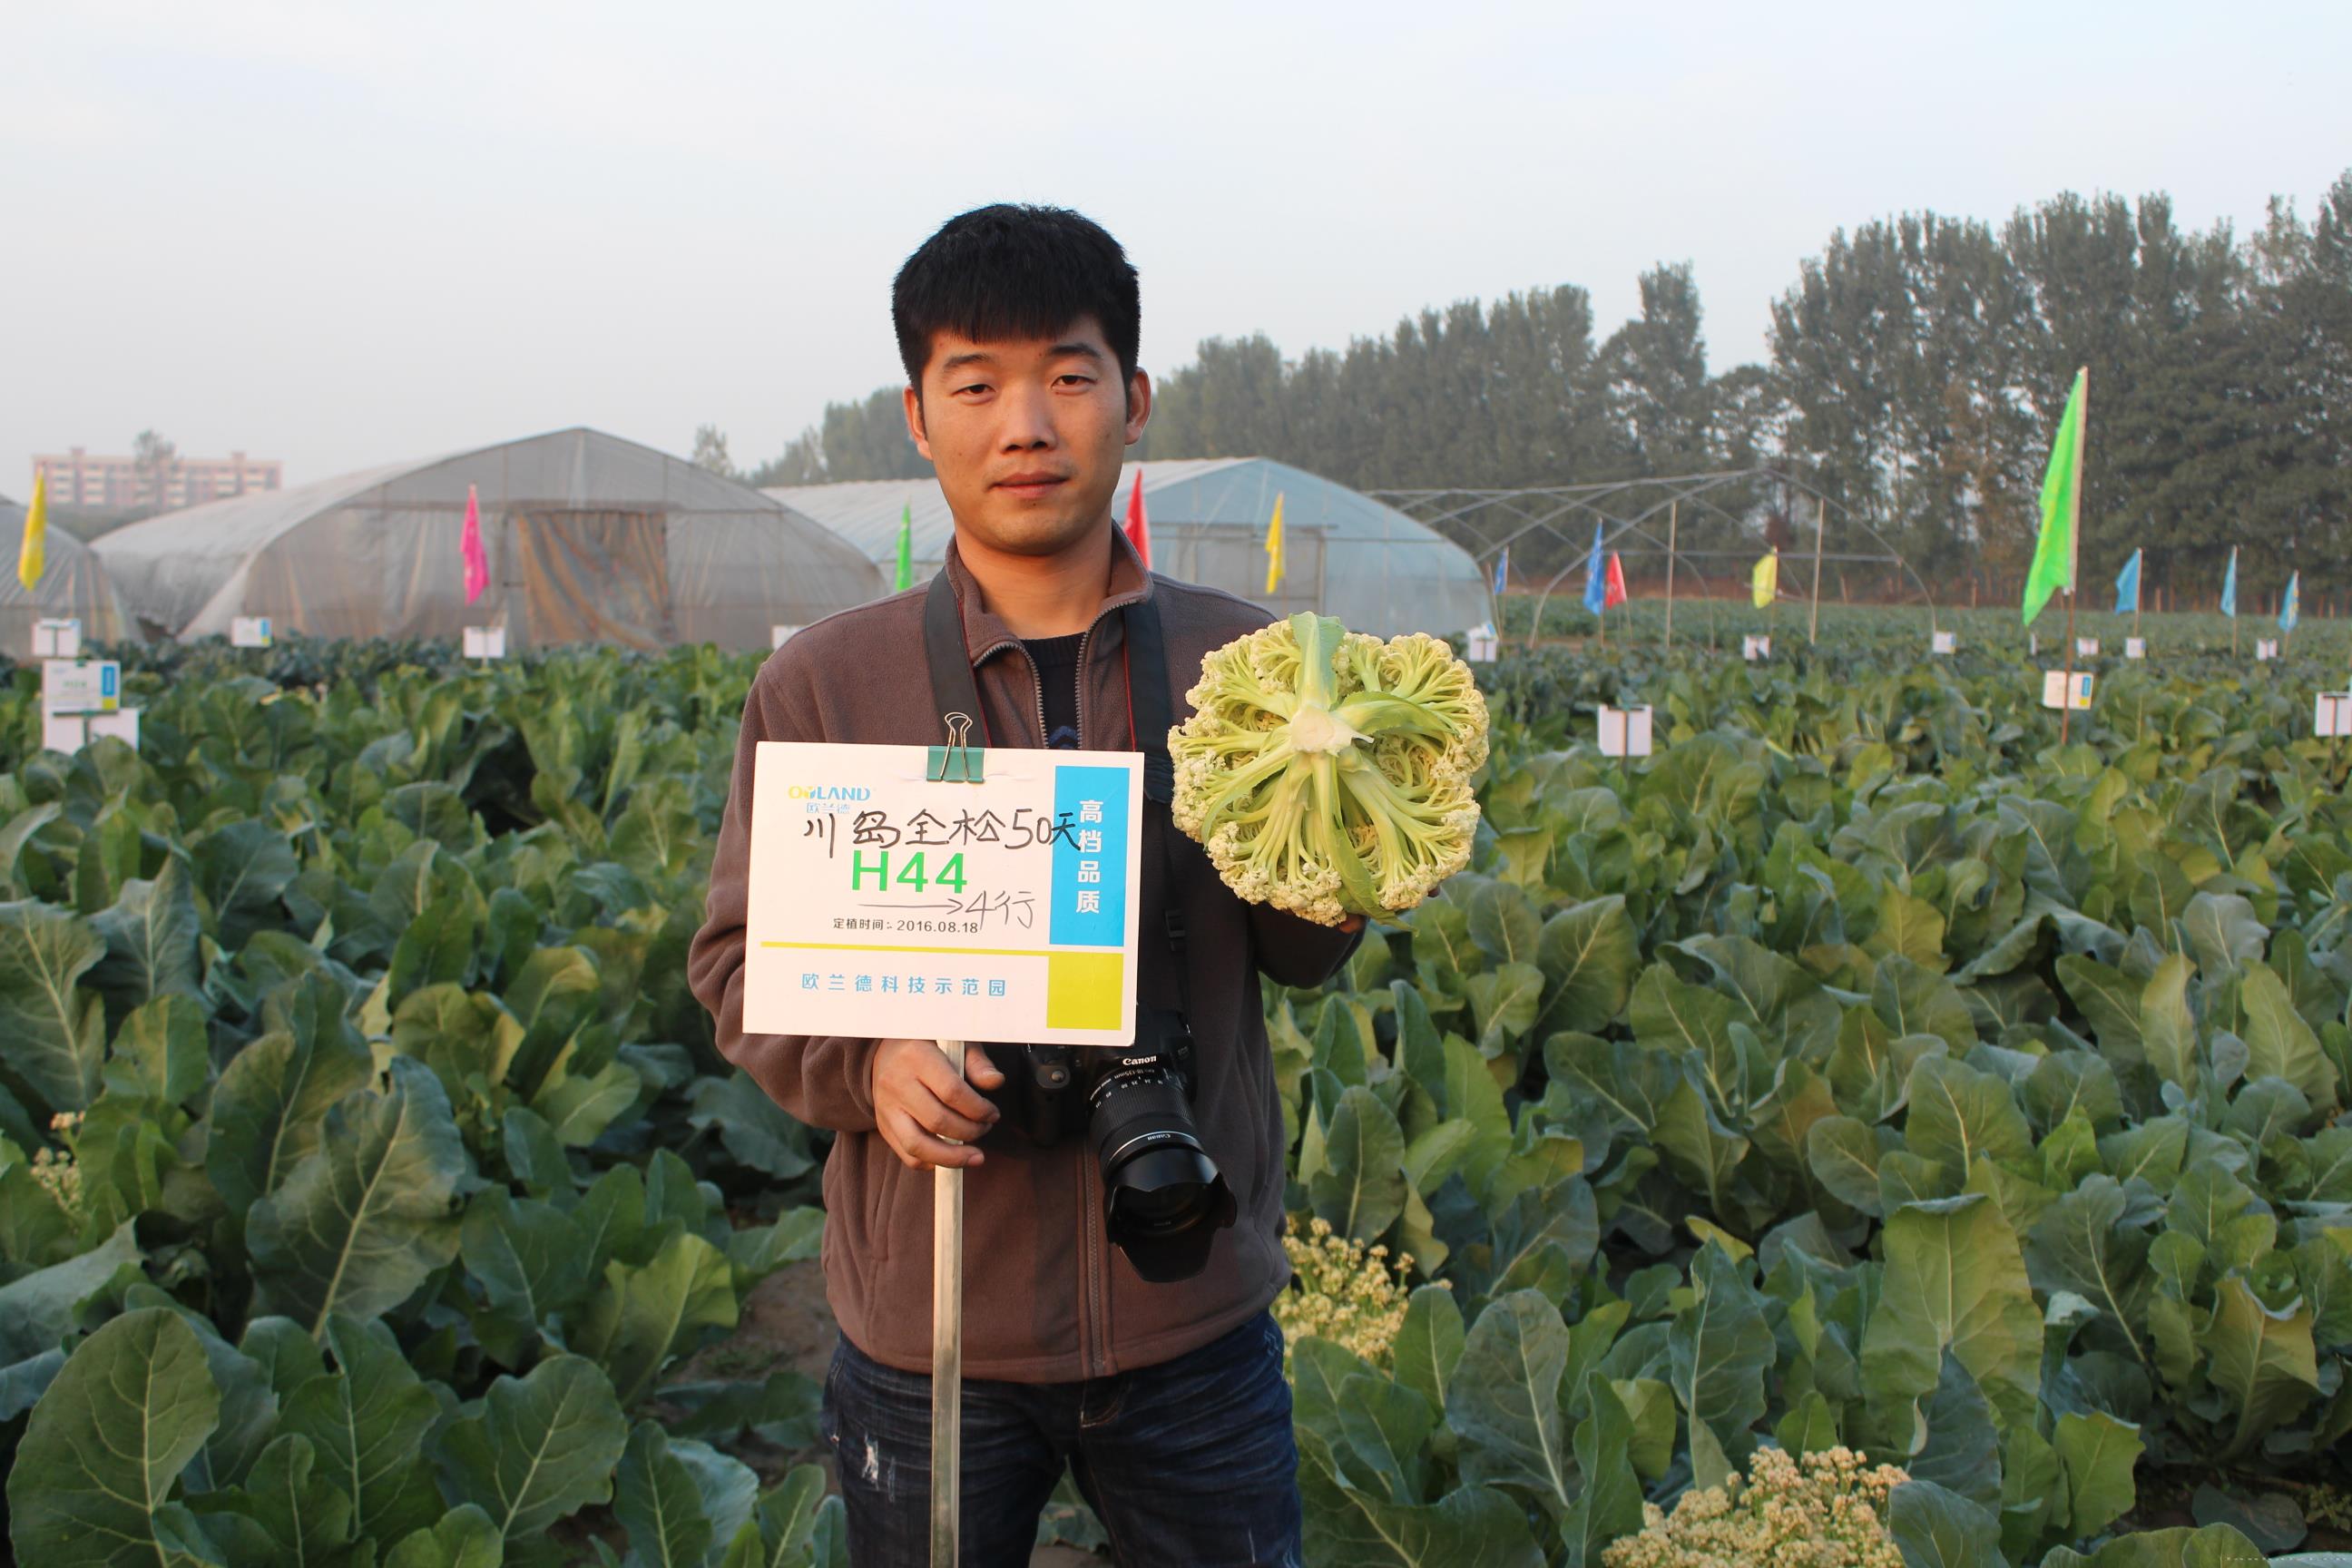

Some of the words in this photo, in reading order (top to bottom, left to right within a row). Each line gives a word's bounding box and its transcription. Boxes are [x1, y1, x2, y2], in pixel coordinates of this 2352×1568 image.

[851, 849, 968, 894] H44
[1076, 799, 1103, 914] 高档品质
[801, 973, 1006, 997] 欧兰德科技示范园
[1122, 1054, 1157, 1066] Canon
